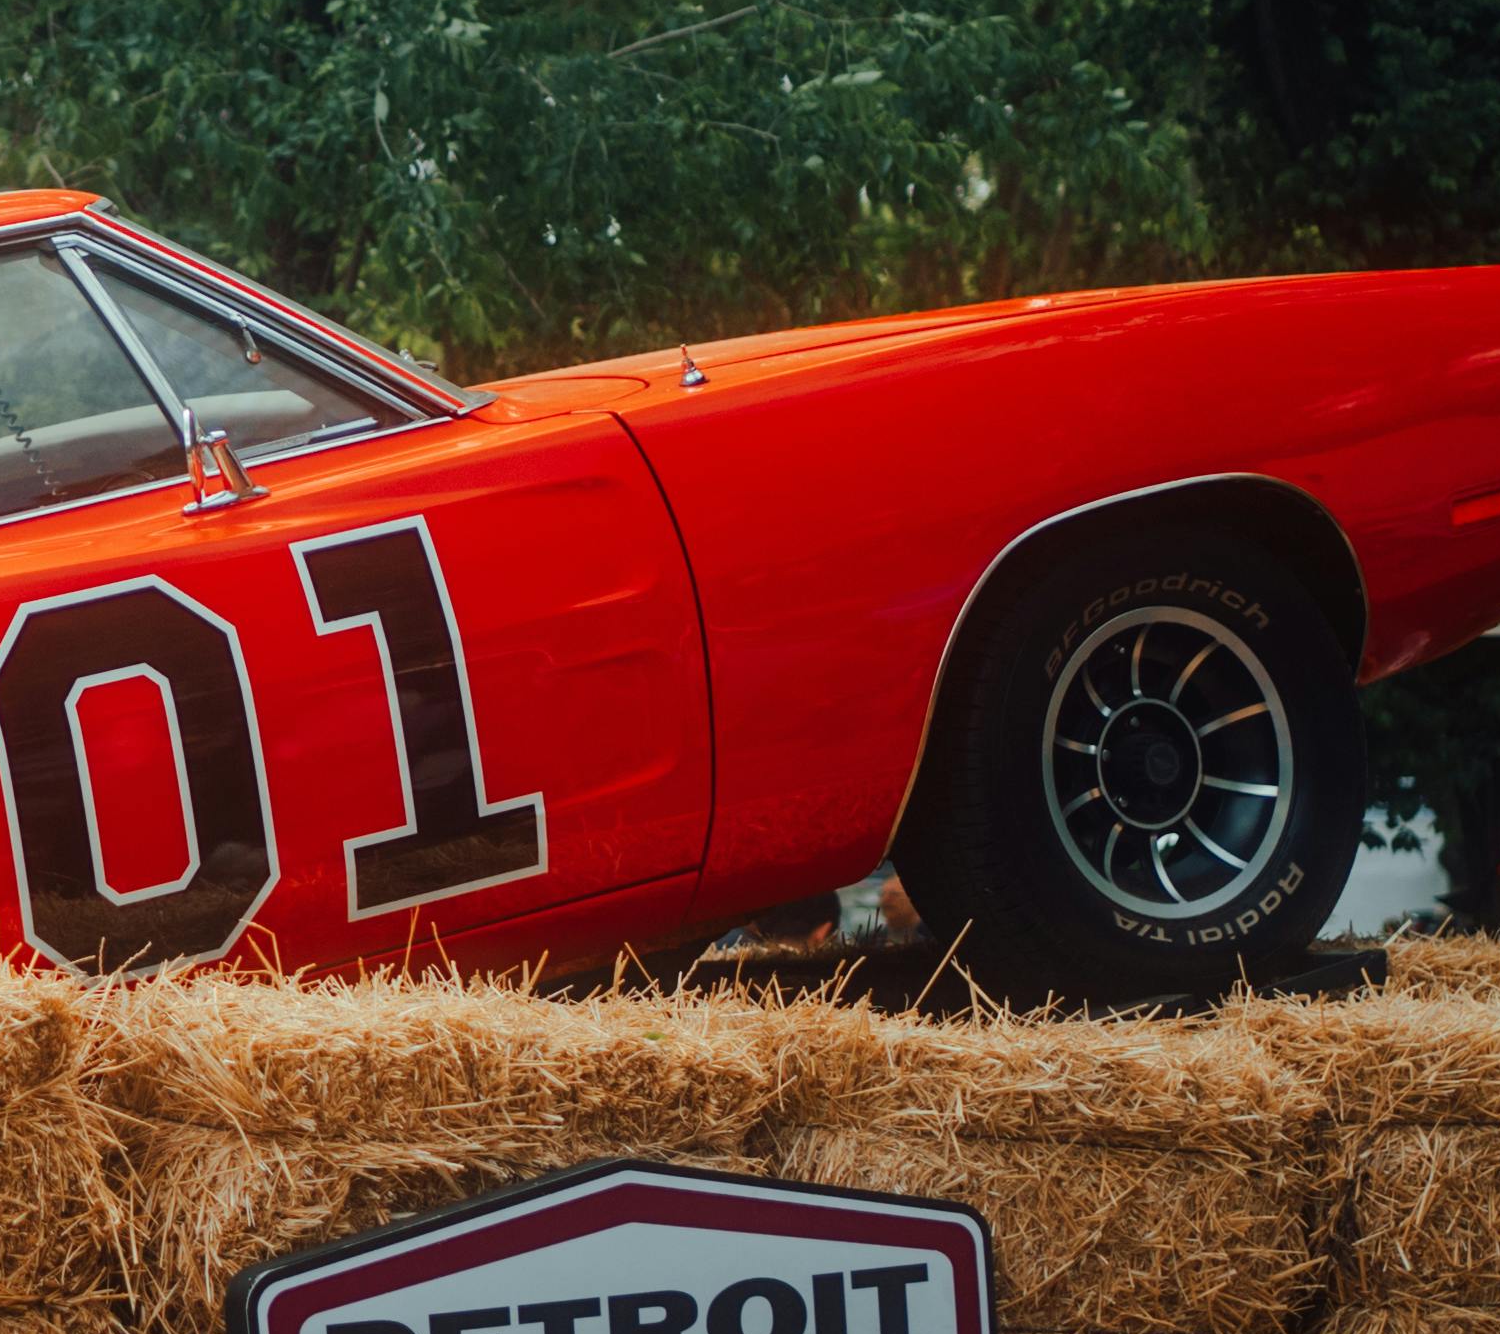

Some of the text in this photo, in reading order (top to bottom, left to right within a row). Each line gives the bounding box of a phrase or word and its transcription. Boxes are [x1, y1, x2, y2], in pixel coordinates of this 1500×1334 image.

[1045, 572, 1271, 682] BFGoodrich
[1113, 862, 1304, 946] Radial T/A
